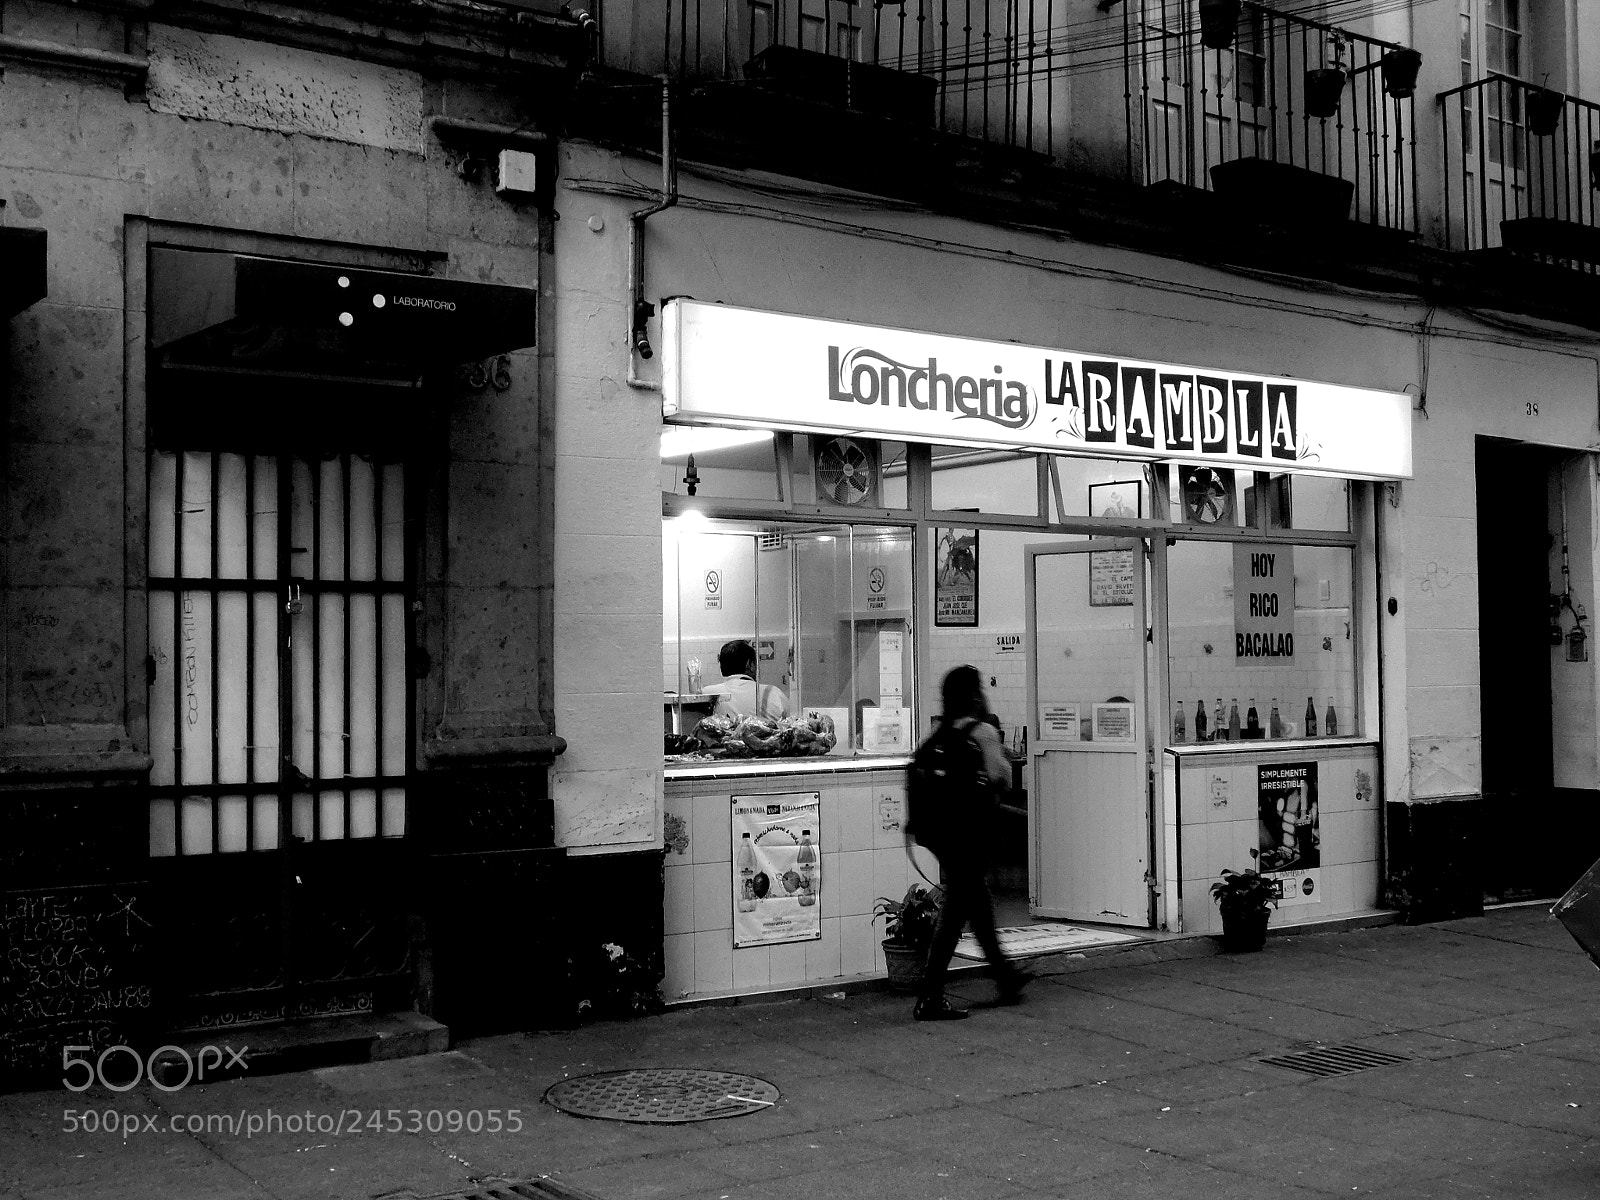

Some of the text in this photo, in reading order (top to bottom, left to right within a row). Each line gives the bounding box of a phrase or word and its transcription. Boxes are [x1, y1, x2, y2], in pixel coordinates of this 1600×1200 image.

[393, 296, 457, 311] LABORATORIO
[828, 345, 1297, 460] Loncheria LA RAMBLA
[1526, 402, 1539, 416] 38
[1251, 553, 1276, 577] HOY
[1249, 592, 1279, 617] RICO
[996, 636, 1020, 645] SALIDA
[1236, 632, 1294, 657] BACALAO
[1261, 769, 1308, 779] SIMPLEMENTE
[1261, 780, 1305, 790] IRRESISTIBLE
